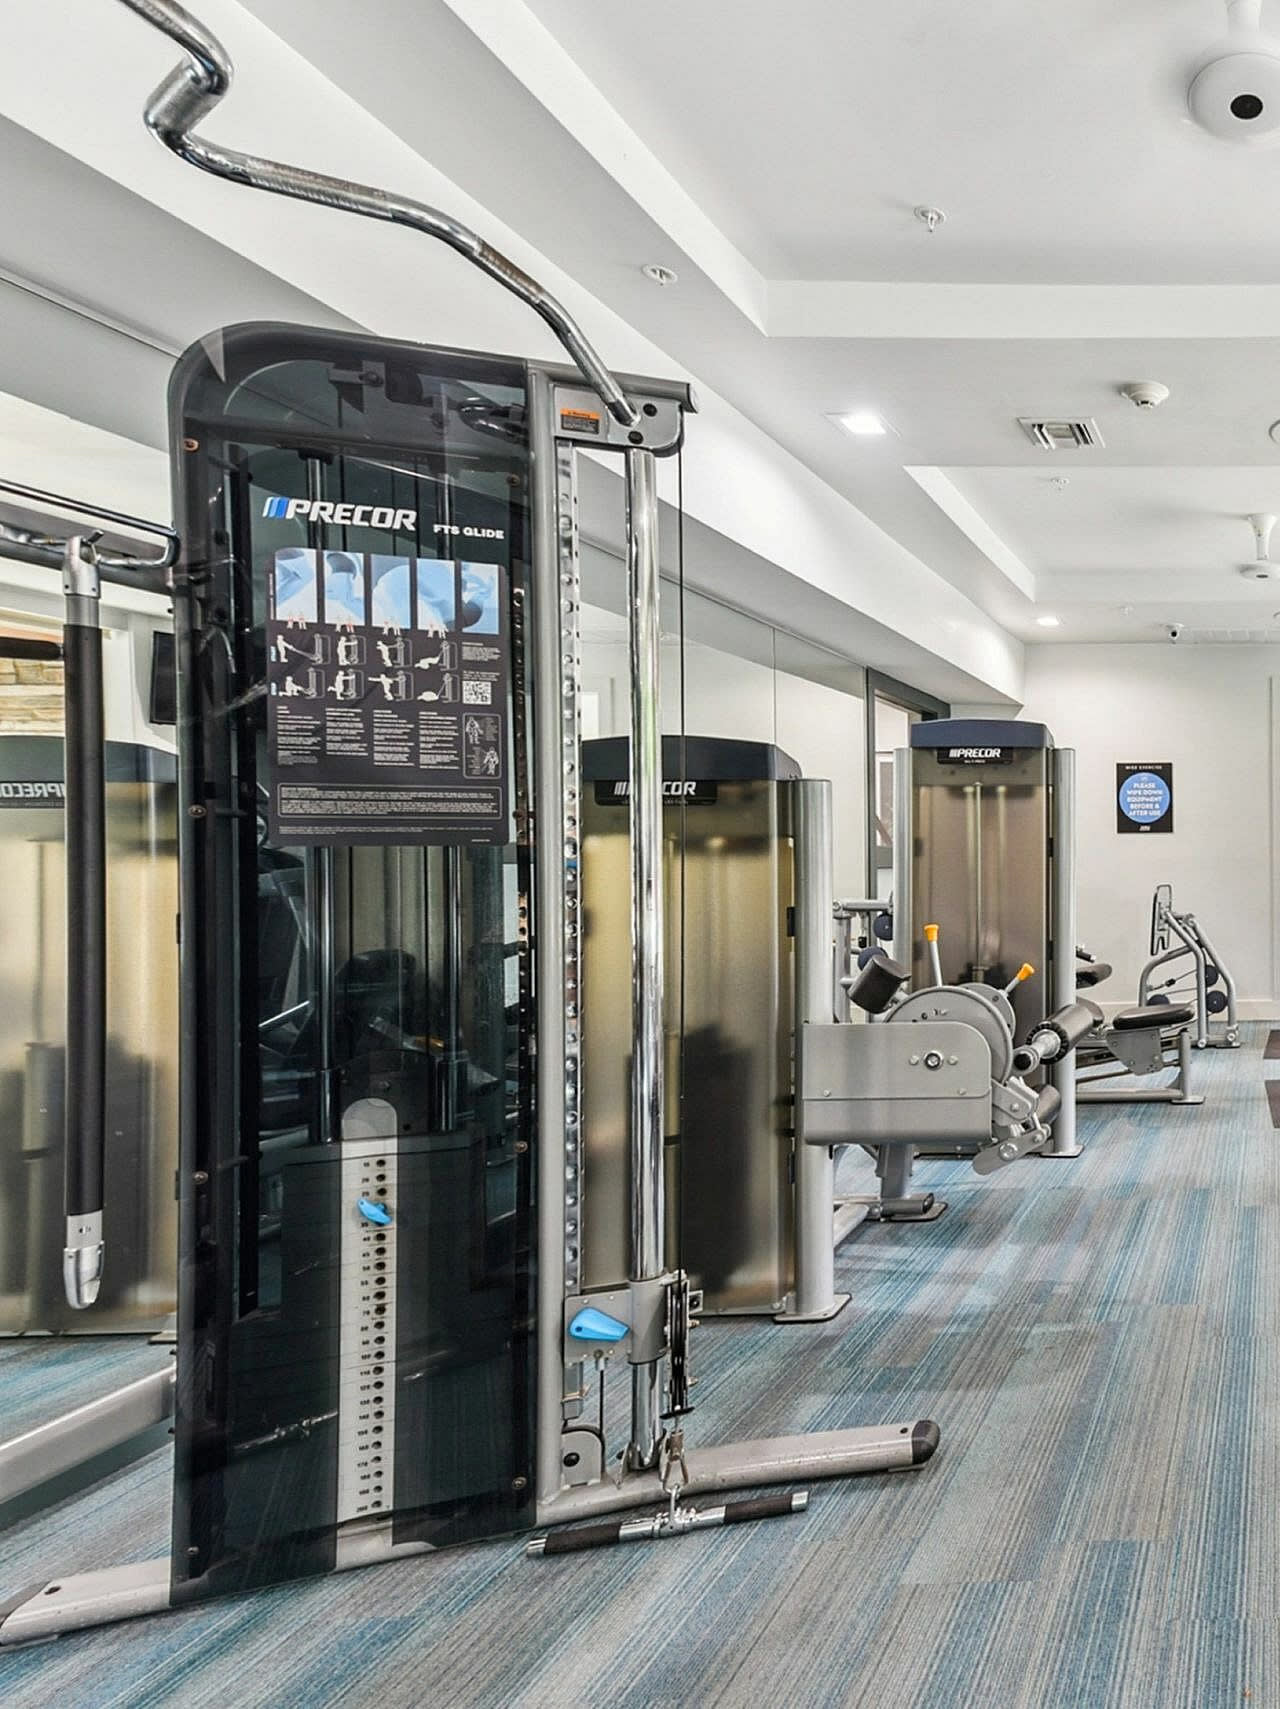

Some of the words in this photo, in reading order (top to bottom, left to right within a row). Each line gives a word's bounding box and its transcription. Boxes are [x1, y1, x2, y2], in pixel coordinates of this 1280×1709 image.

[285, 498, 418, 532] PRECOR
[433, 524, 461, 536] FTS
[463, 527, 505, 540] GLIDE
[957, 748, 1001, 758] PRECOR
